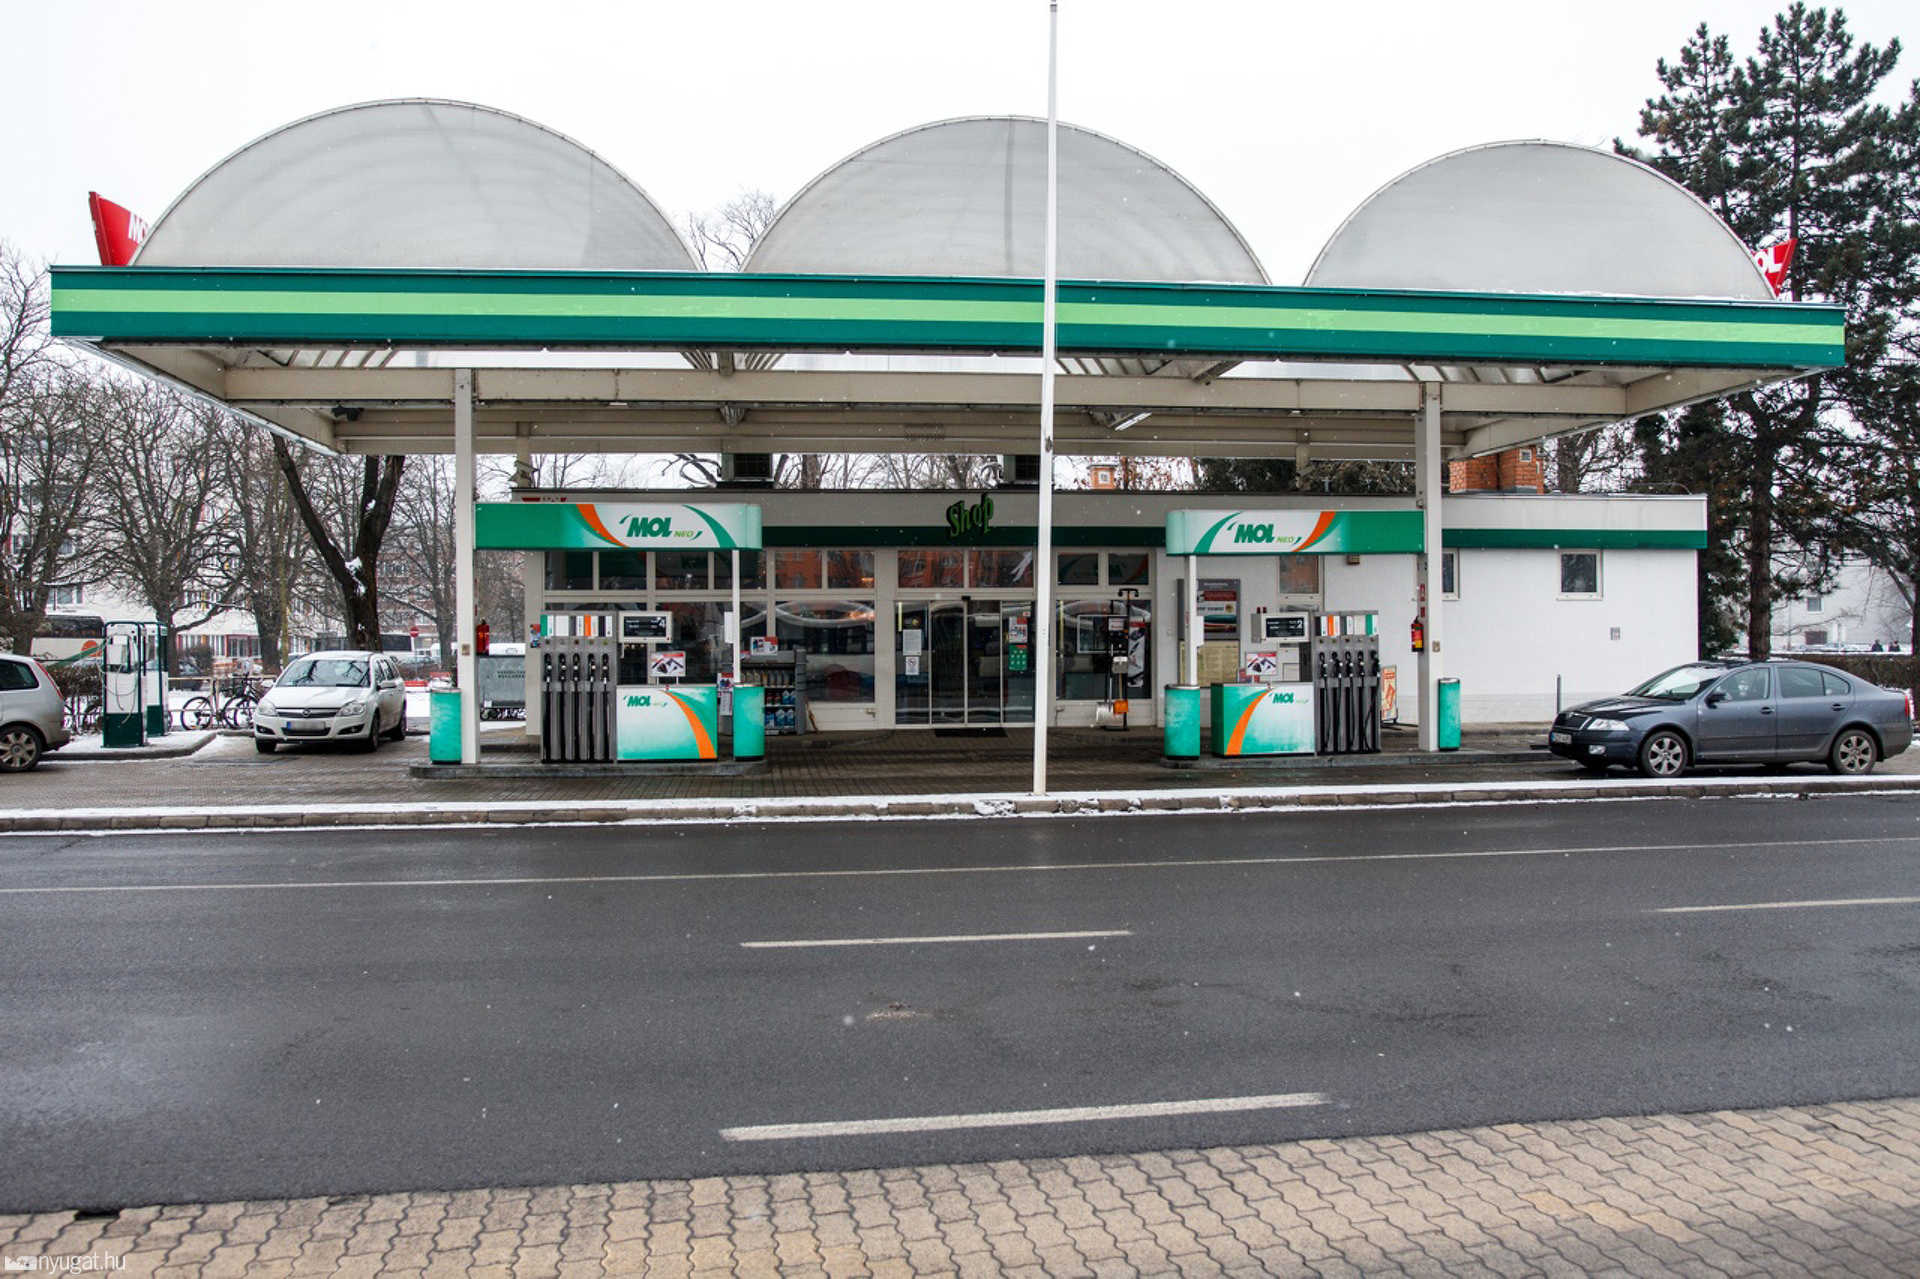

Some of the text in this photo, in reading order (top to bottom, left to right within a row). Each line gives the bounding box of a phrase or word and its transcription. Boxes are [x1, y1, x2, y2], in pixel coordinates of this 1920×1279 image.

[1754, 246, 1783, 274] OL
[947, 494, 994, 537] Shop
[626, 517, 672, 538] MOL
[1234, 524, 1275, 544] MOL
[627, 695, 651, 707] MOL
[1272, 692, 1294, 705] MOL
